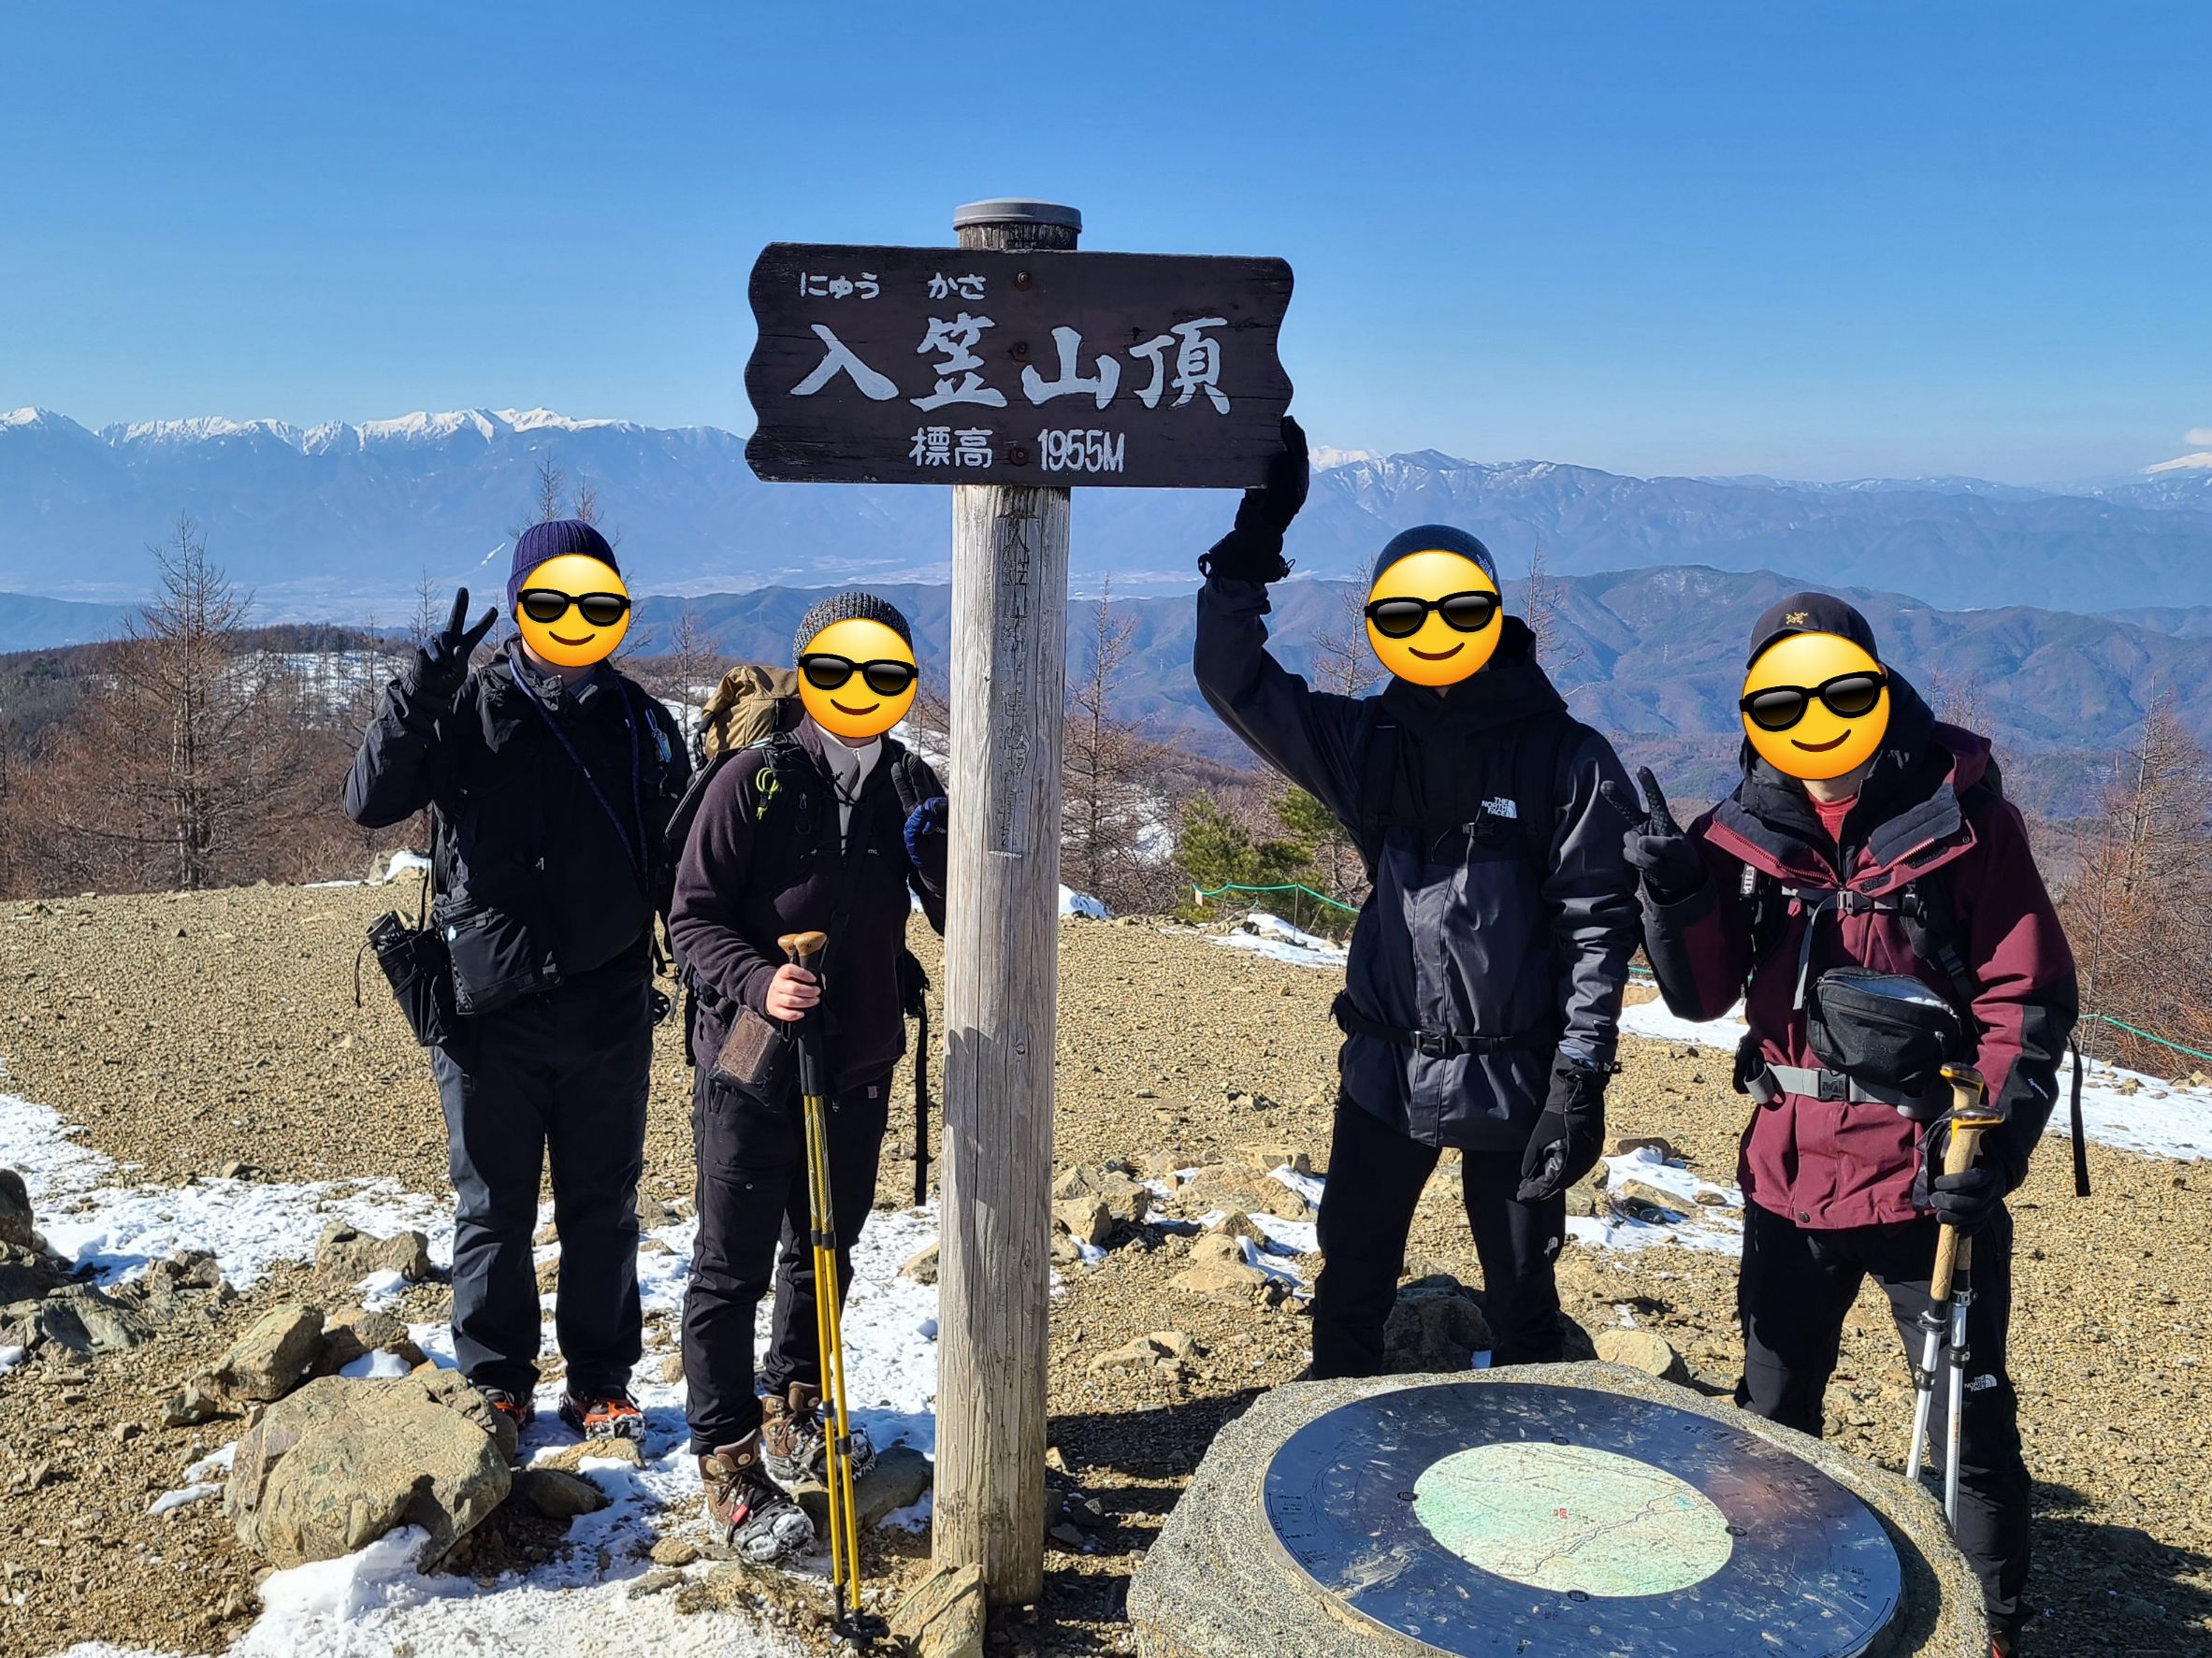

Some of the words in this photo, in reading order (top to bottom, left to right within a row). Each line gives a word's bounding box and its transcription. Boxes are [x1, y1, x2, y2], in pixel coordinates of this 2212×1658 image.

[801, 272, 879, 299] にゅう
[927, 272, 987, 300] かさ
[789, 311, 1231, 414] 入笠山頂
[908, 425, 993, 469] 標高
[1037, 427, 1126, 472] 1955M
[1481, 800, 1508, 812] NORTH
[1494, 796, 1509, 805] THE
[1487, 807, 1508, 817] FACE
